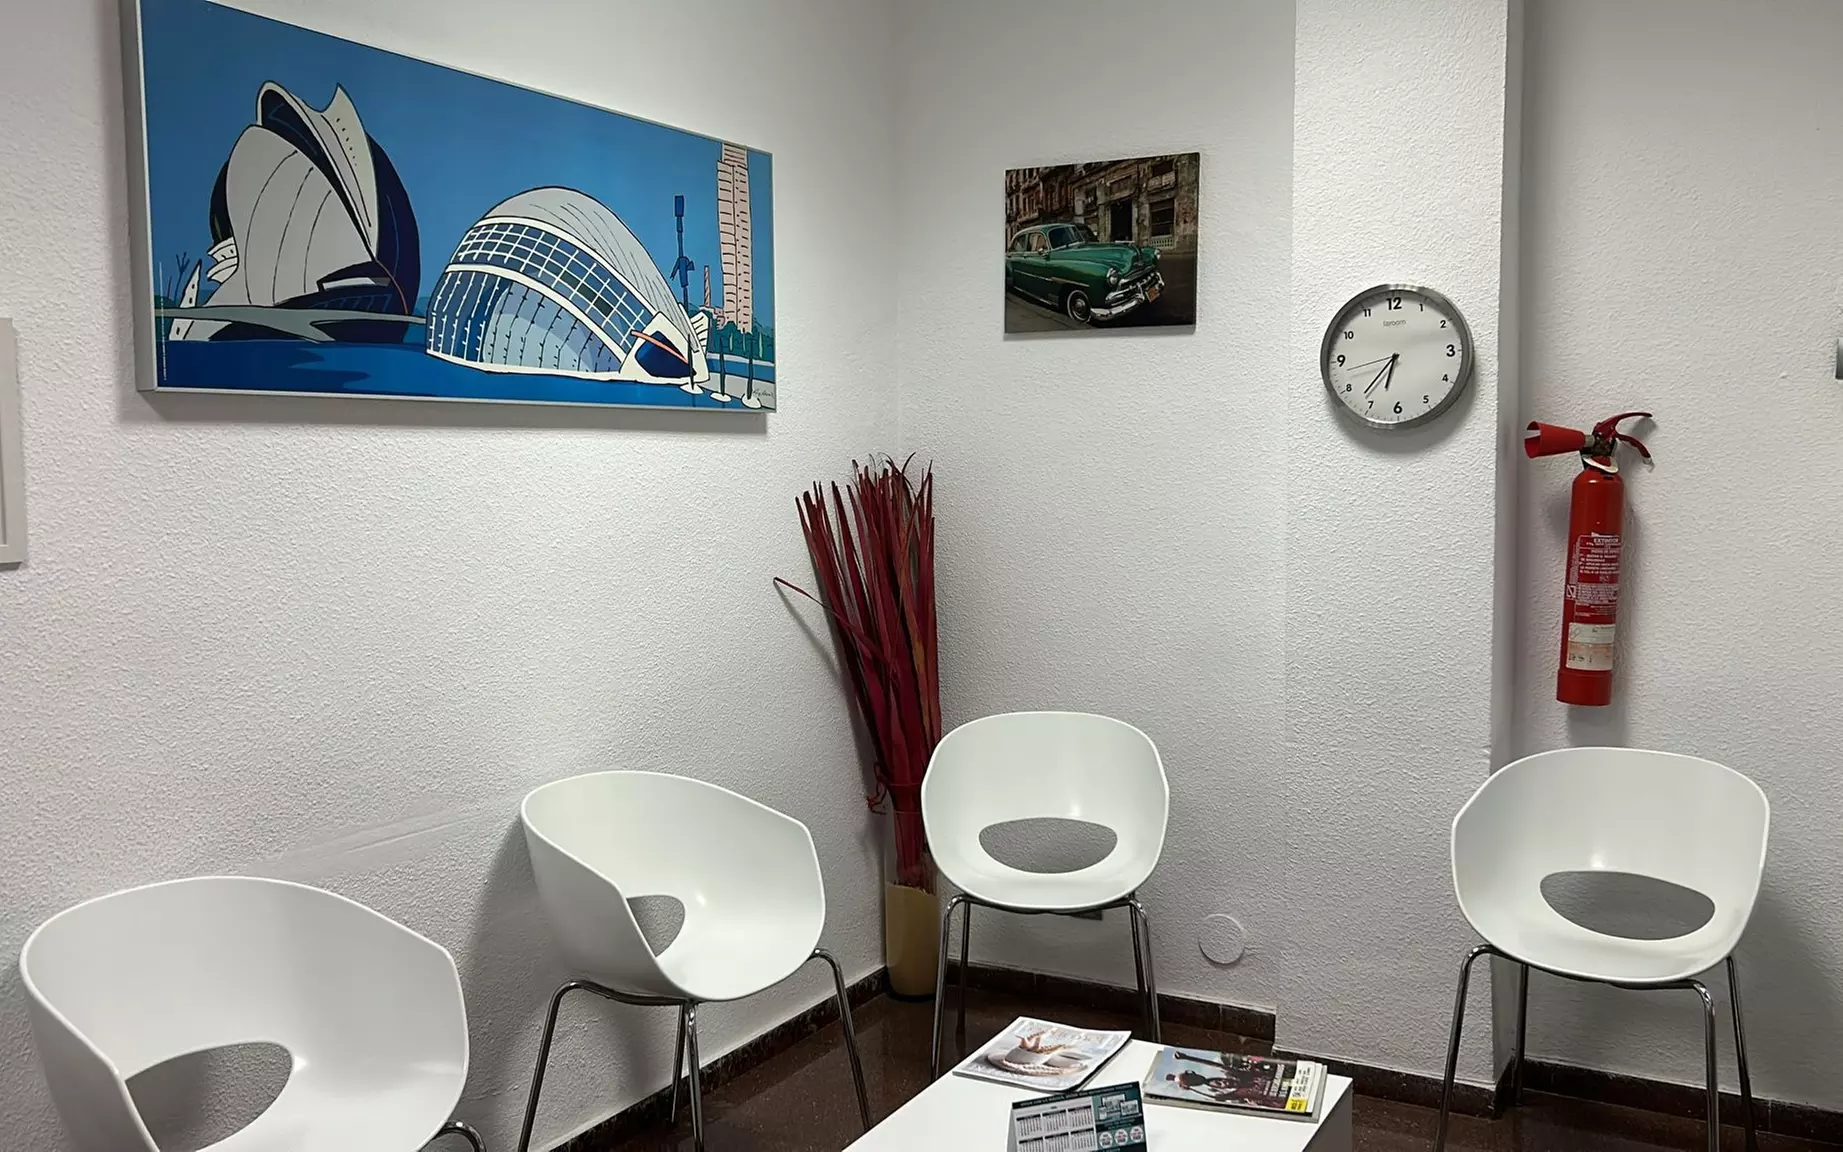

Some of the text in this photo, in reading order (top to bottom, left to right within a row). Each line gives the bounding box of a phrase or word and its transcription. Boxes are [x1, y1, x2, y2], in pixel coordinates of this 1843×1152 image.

[1386, 297, 1402, 310] 12
[1419, 303, 1424, 312] 1
[1364, 309, 1371, 317] 11
[1440, 320, 1447, 328] 2
[1344, 331, 1354, 340] 10
[1446, 344, 1455, 357] 3
[1337, 355, 1346, 367] 9
[1442, 374, 1449, 382] 4
[1346, 384, 1352, 392] 8
[1423, 395, 1429, 403] 5
[1368, 401, 1374, 409] 7
[1393, 401, 1402, 414] 6
